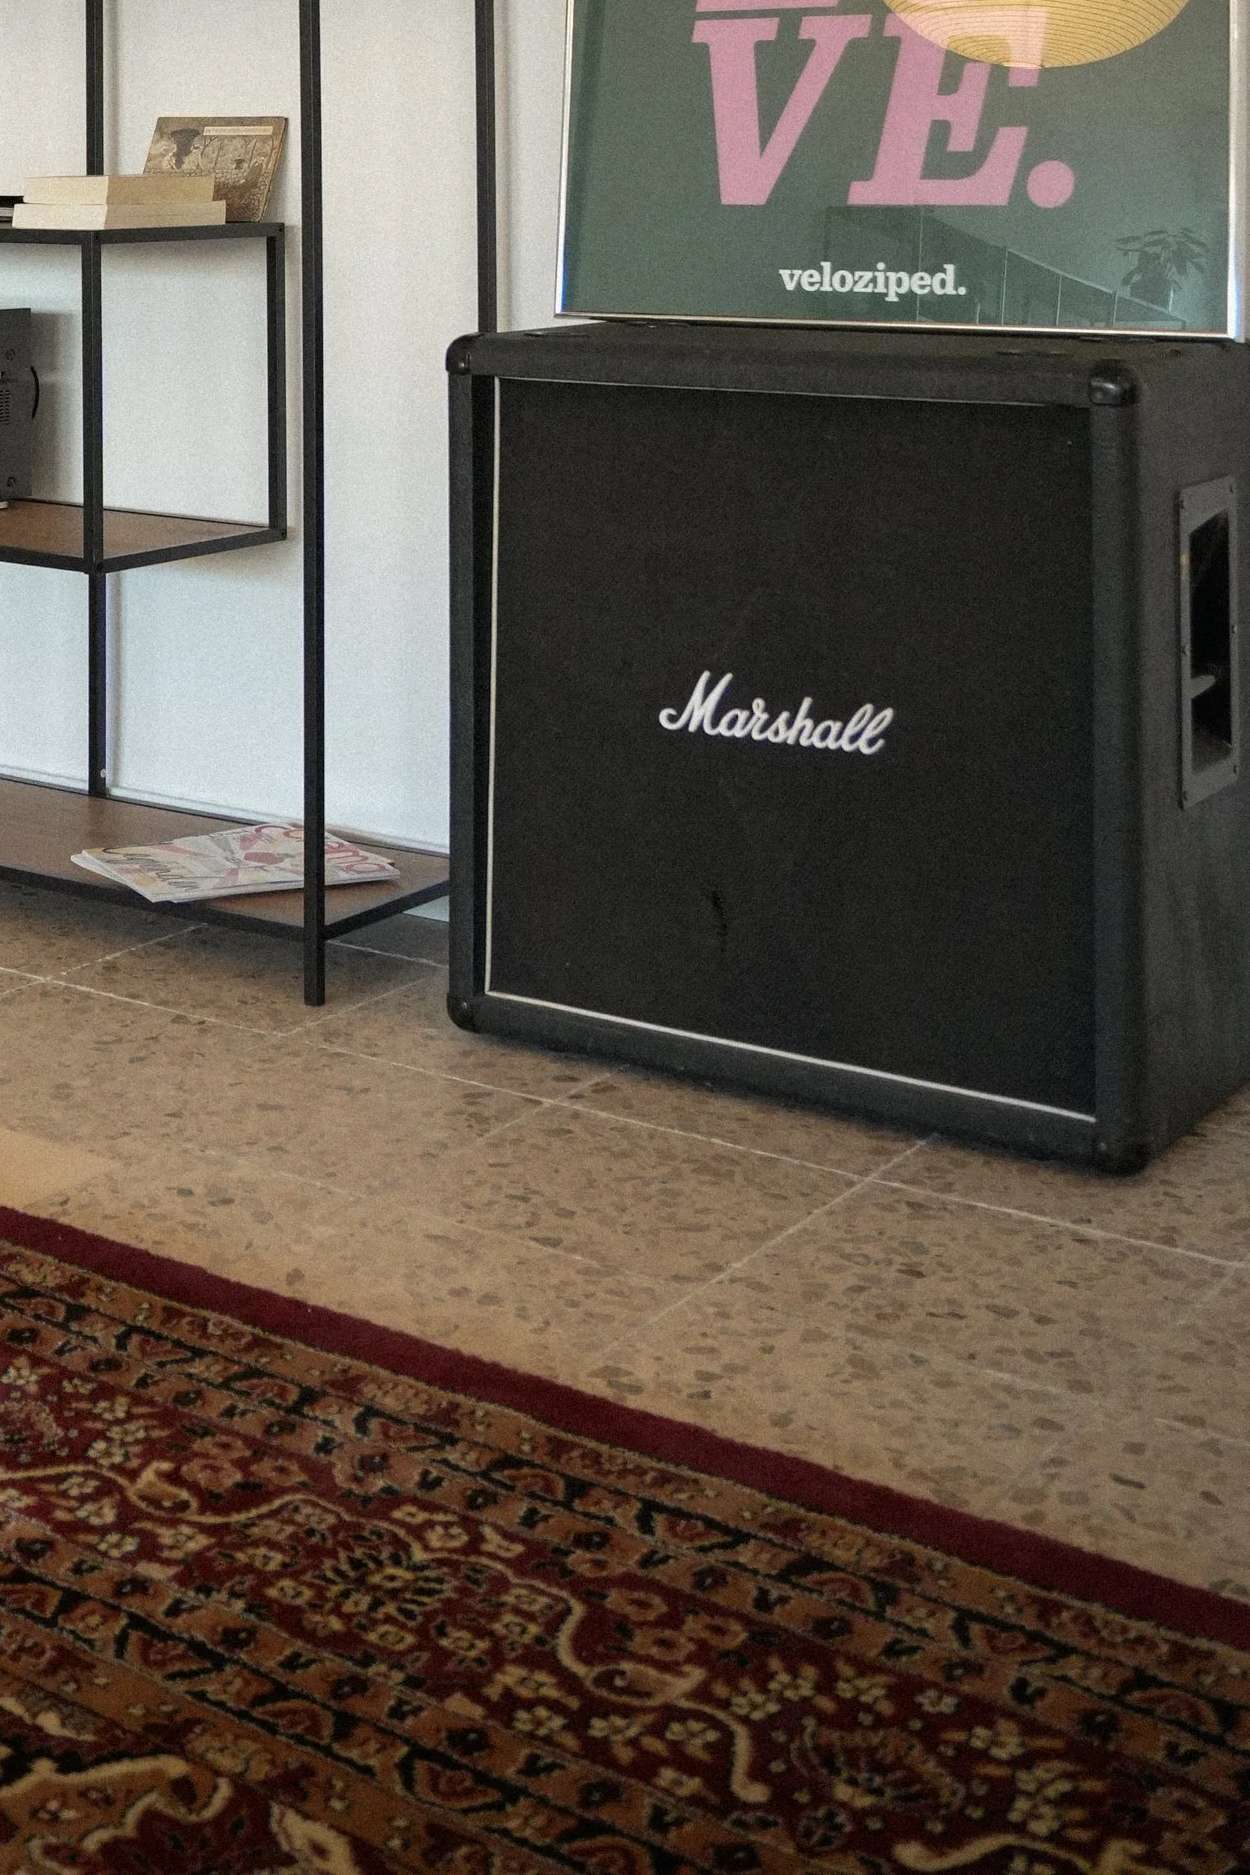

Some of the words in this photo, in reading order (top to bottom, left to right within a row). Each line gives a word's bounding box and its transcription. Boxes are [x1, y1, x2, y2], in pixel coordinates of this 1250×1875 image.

[692, 7, 1076, 209] VE.
[778, 261, 967, 302] veloziped.
[658, 670, 894, 755] Marshall
